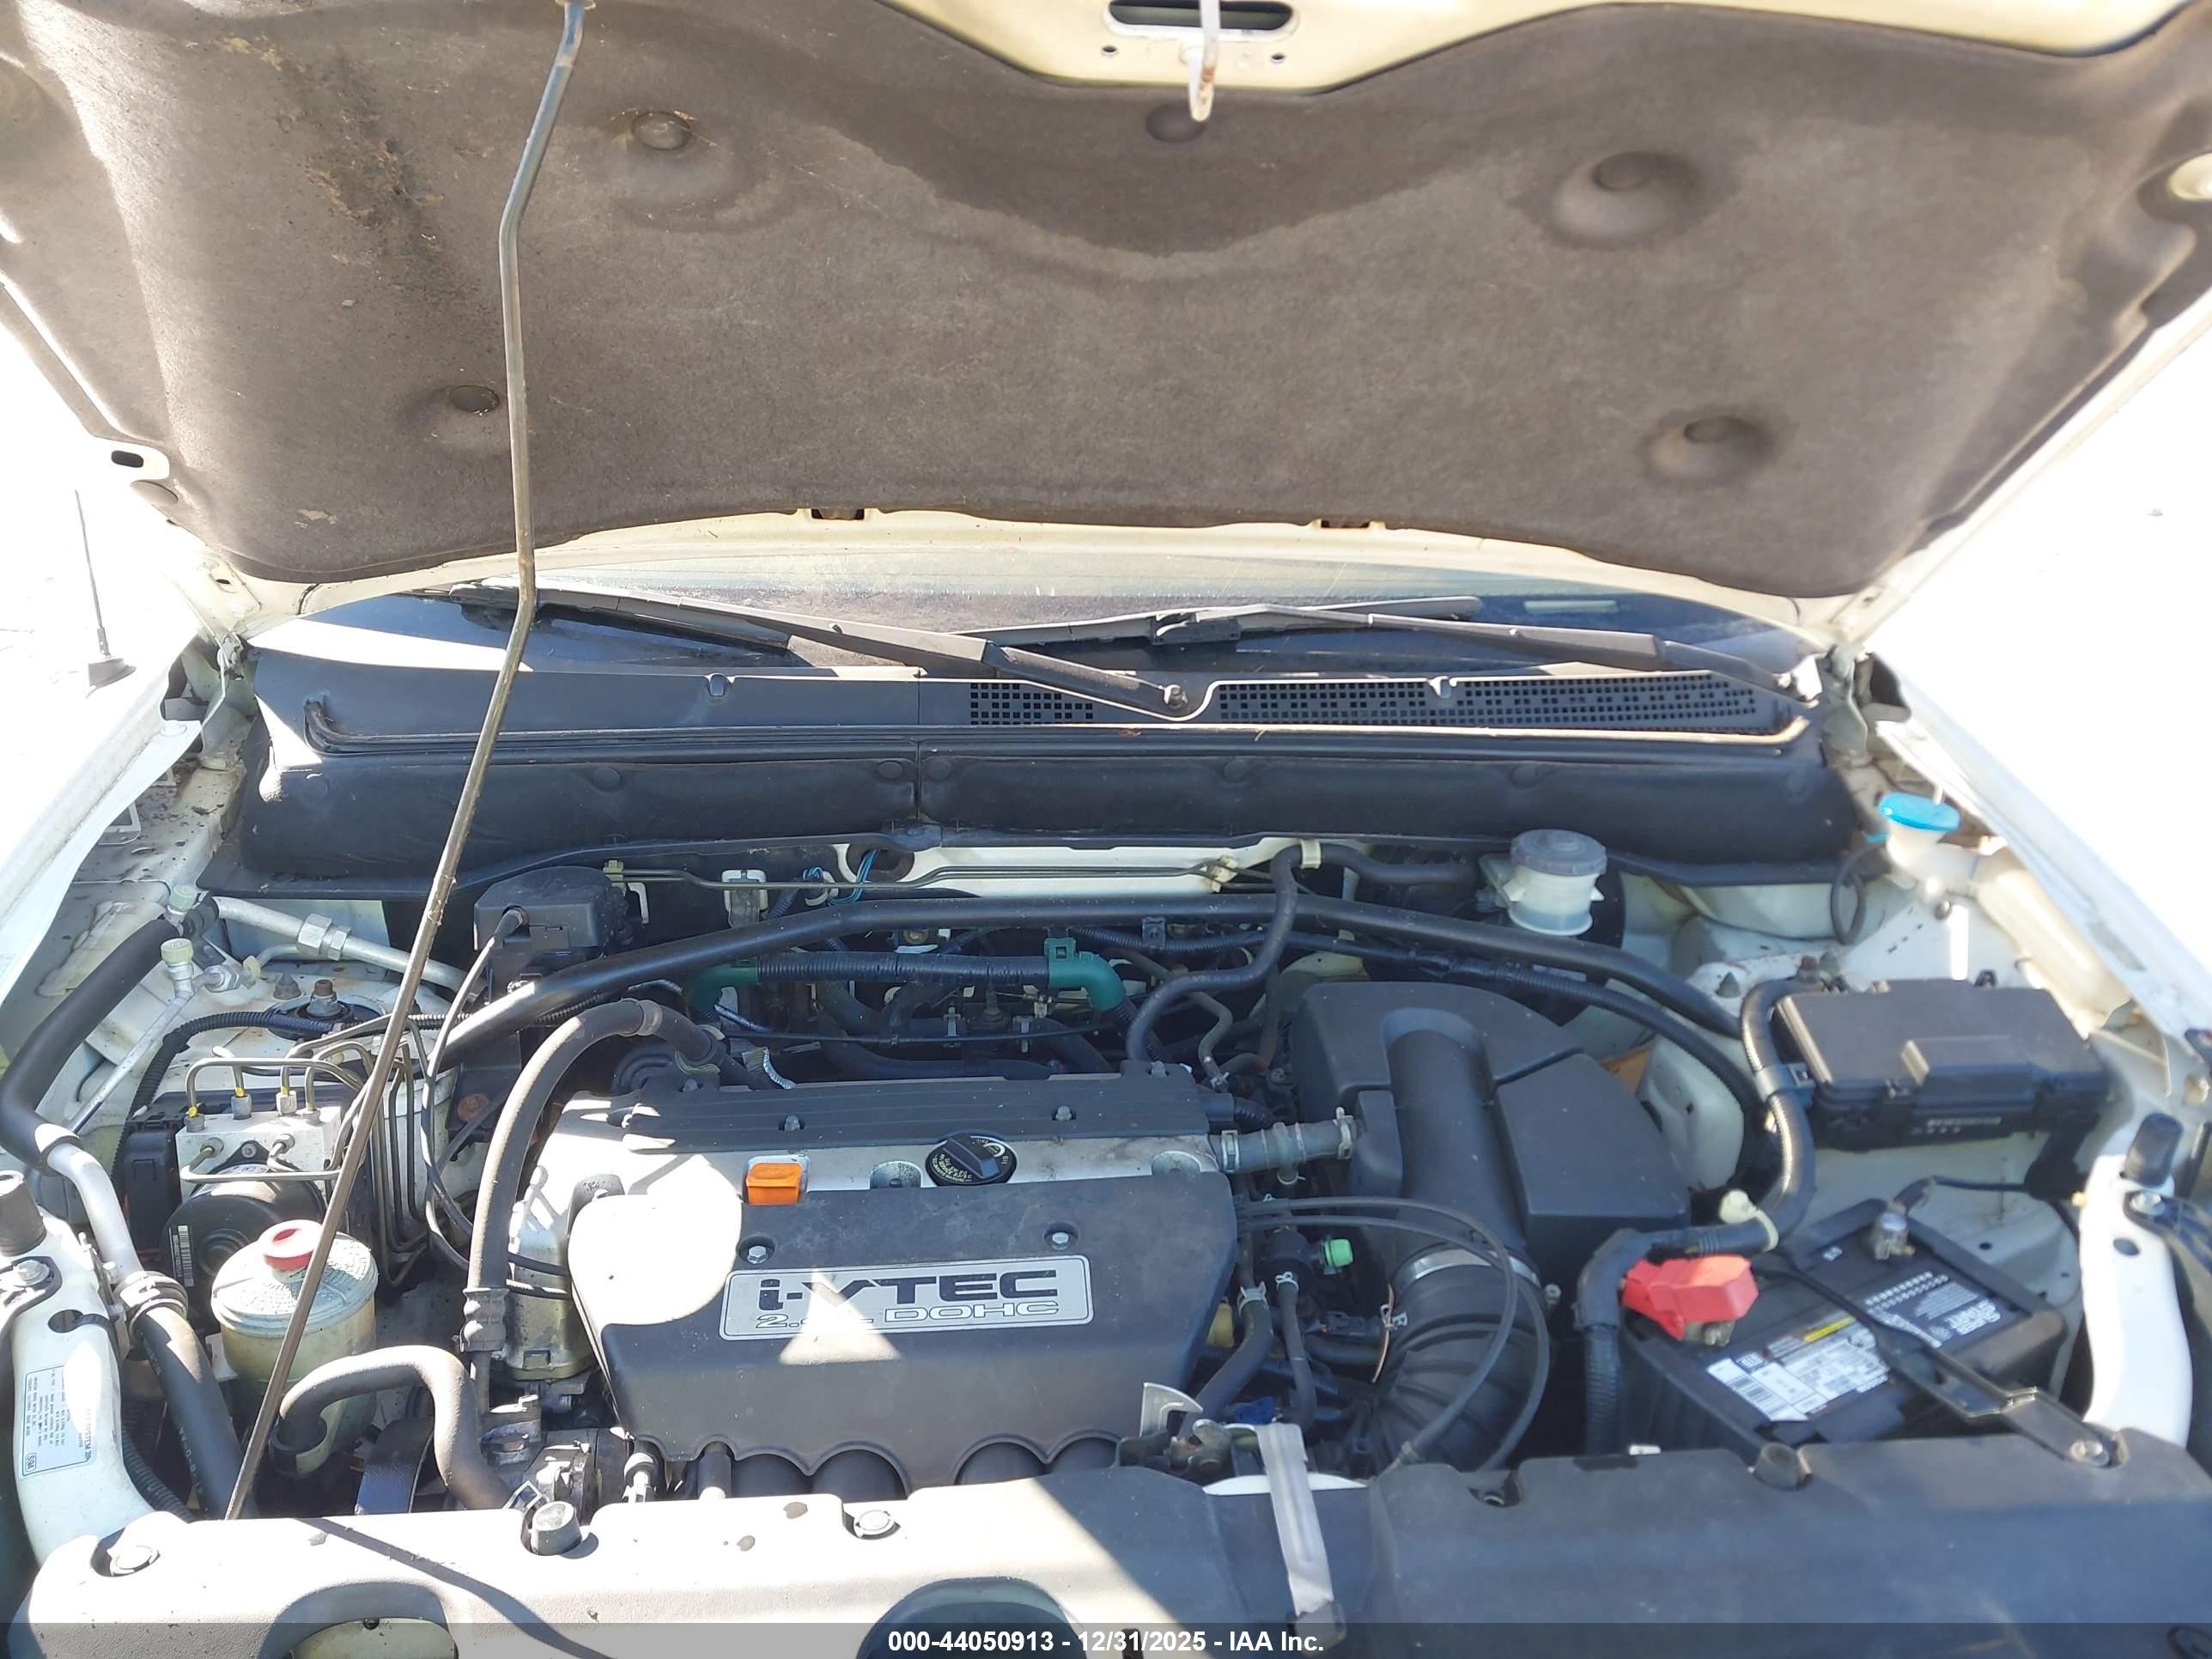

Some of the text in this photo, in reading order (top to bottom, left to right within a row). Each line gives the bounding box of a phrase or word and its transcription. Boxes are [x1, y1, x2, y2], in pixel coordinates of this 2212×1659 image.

[758, 1270, 1058, 1310] i-VTEC
[884, 1301, 1060, 1322] DOHC
[27, 1455, 35, 1469] S9A
